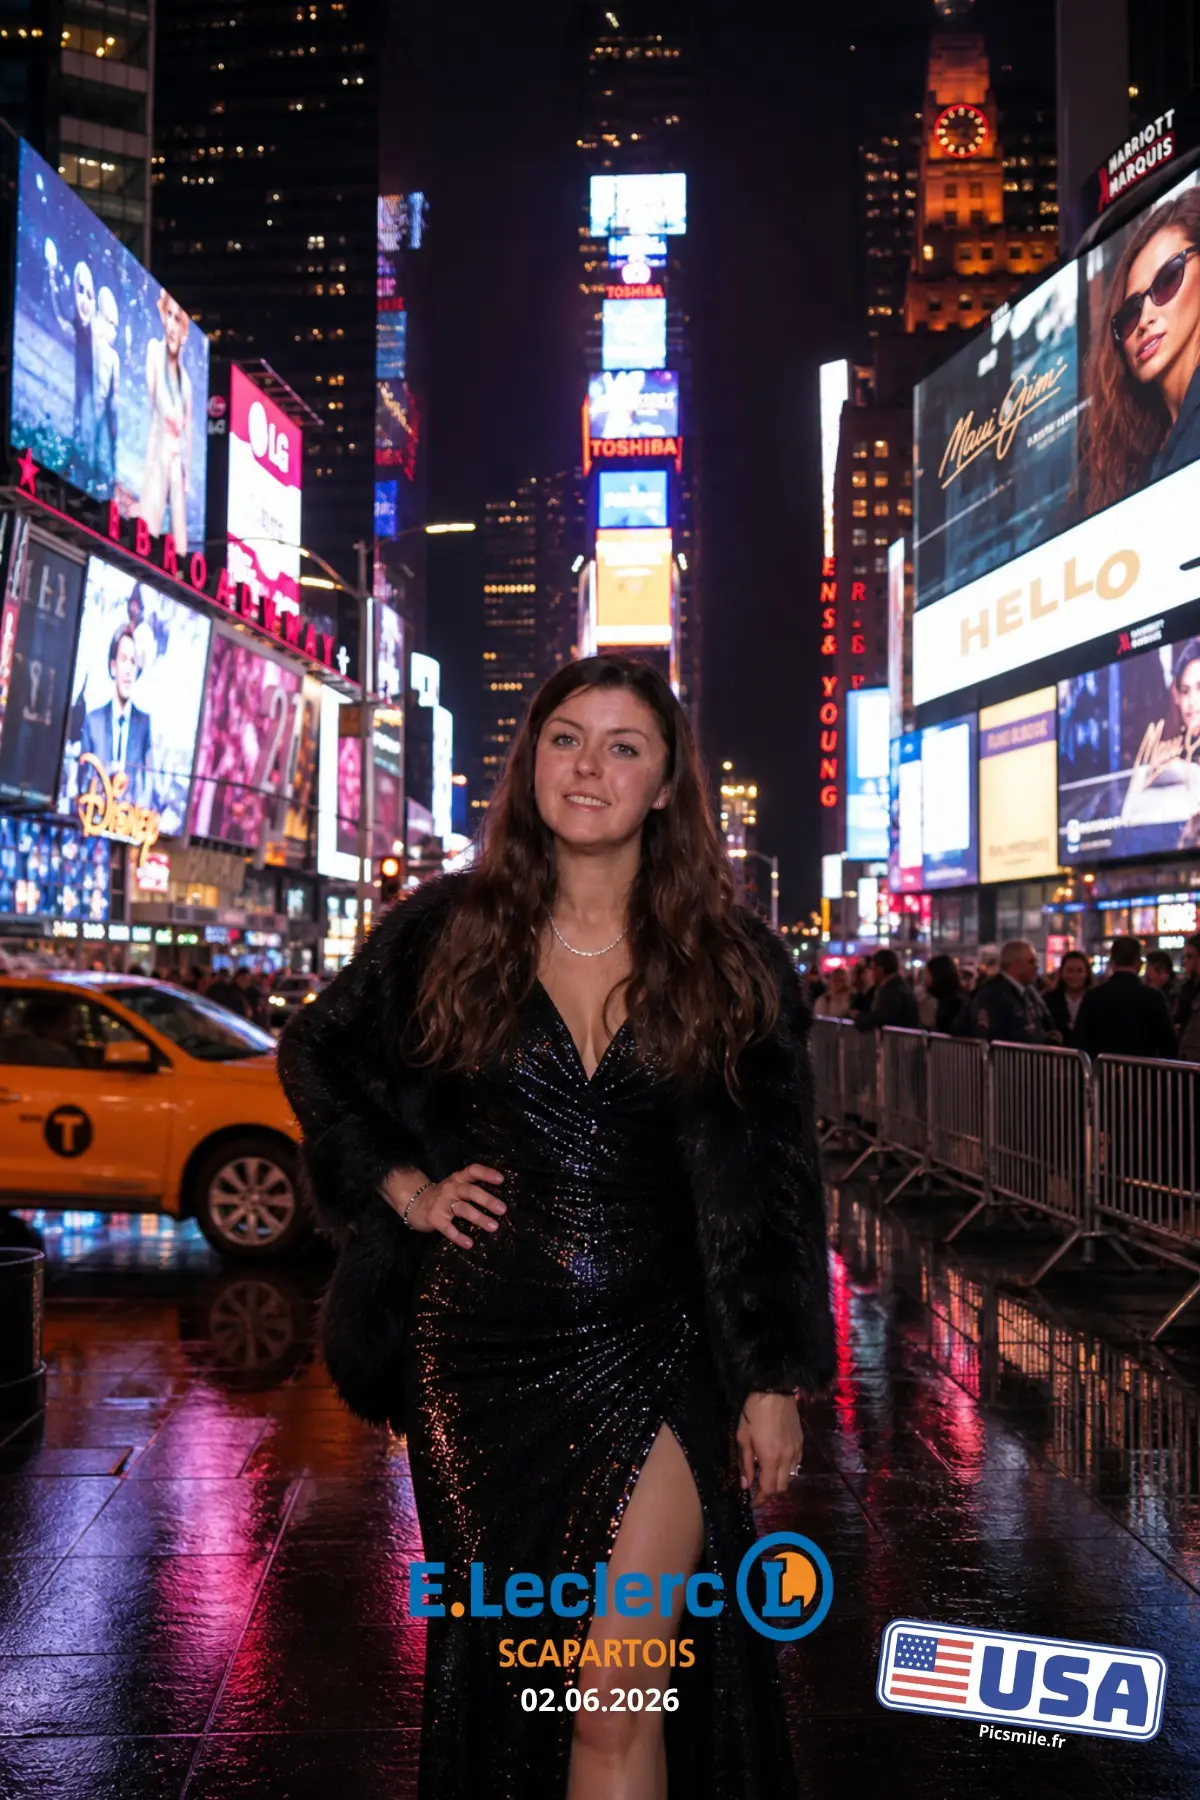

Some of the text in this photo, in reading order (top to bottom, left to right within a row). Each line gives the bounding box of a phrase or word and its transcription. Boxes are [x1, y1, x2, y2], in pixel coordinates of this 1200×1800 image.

[1108, 108, 1175, 175] MARRIOTT
[1109, 137, 1172, 198] MARQUIS
[605, 283, 664, 299] TOSHIBA
[268, 422, 289, 474] LG
[591, 438, 678, 457] TOSHIBA
[938, 410, 996, 478] Maui
[960, 549, 1141, 657] HELLO
[820, 675, 838, 808] YOUNG
[53, 1114, 84, 1152] T
